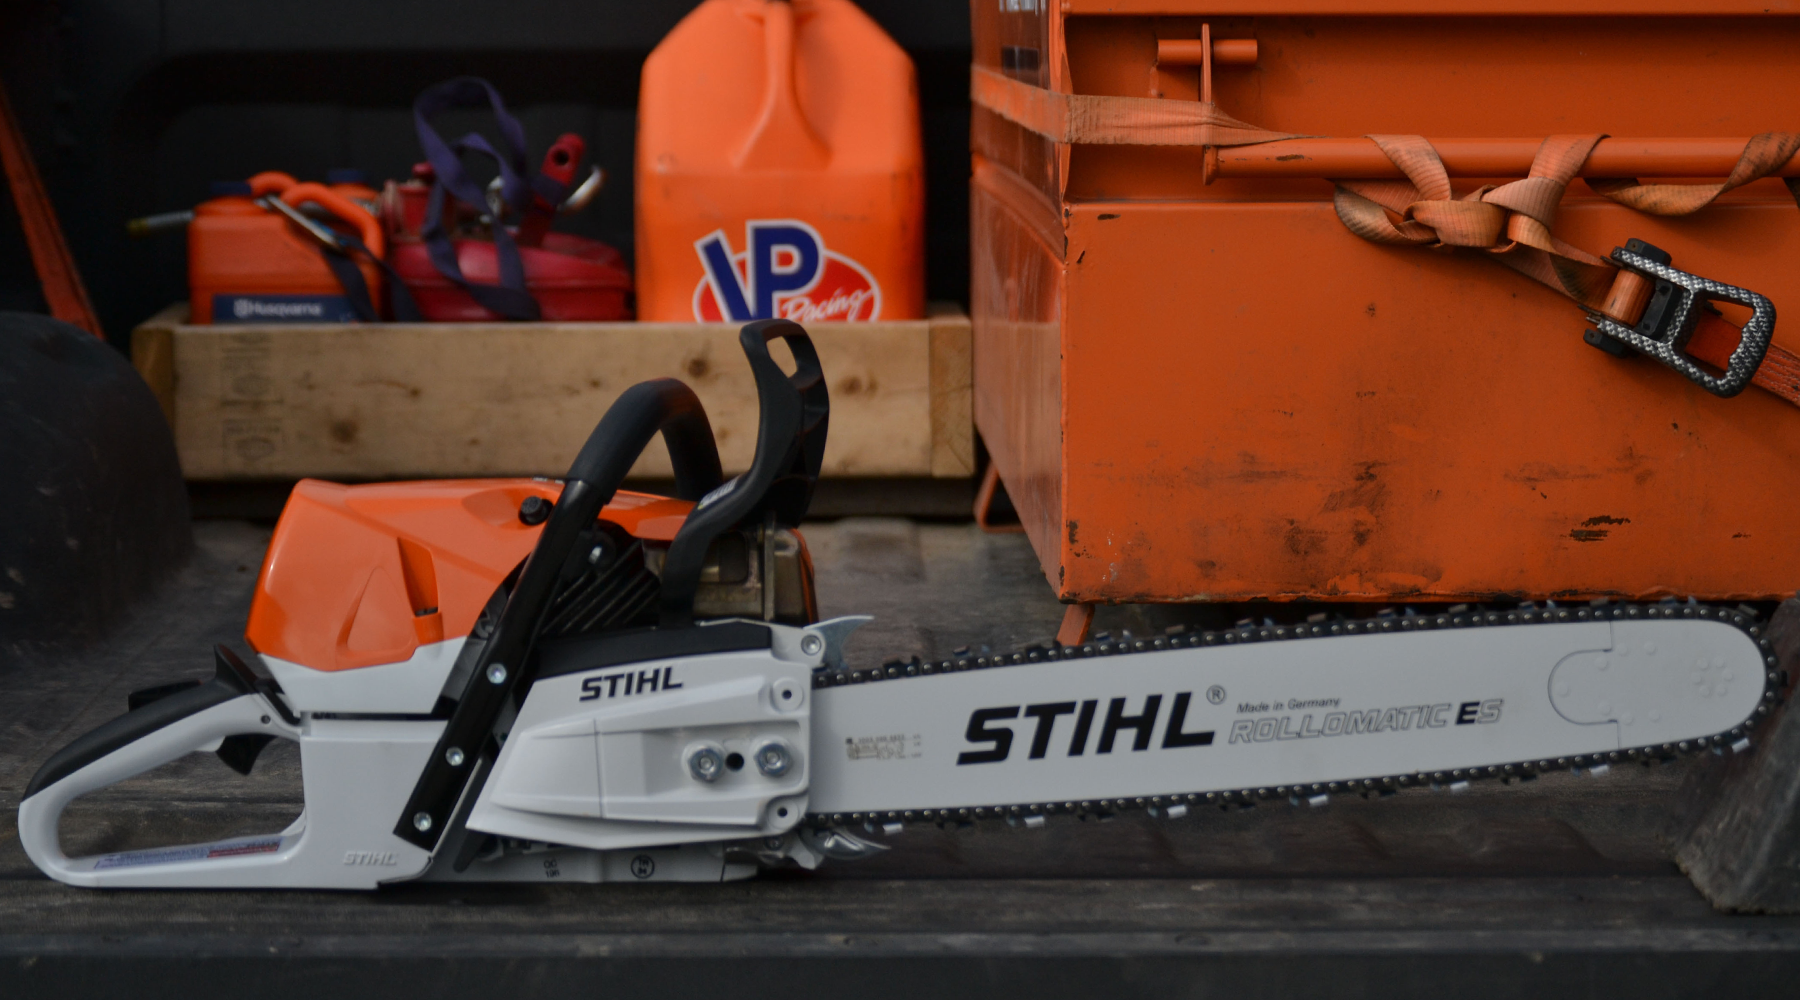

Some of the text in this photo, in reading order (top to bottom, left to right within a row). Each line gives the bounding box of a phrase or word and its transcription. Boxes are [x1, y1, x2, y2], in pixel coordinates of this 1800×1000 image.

[695, 219, 824, 322] VP
[253, 301, 322, 317] Husqvarna
[782, 288, 874, 322] Racing
[579, 666, 683, 701] STIHL
[1228, 698, 1504, 744] ROLLOMATIC ES
[1237, 697, 1341, 714] Made in Germany
[956, 691, 1215, 766] STIHL
[343, 850, 397, 867] STIHL
